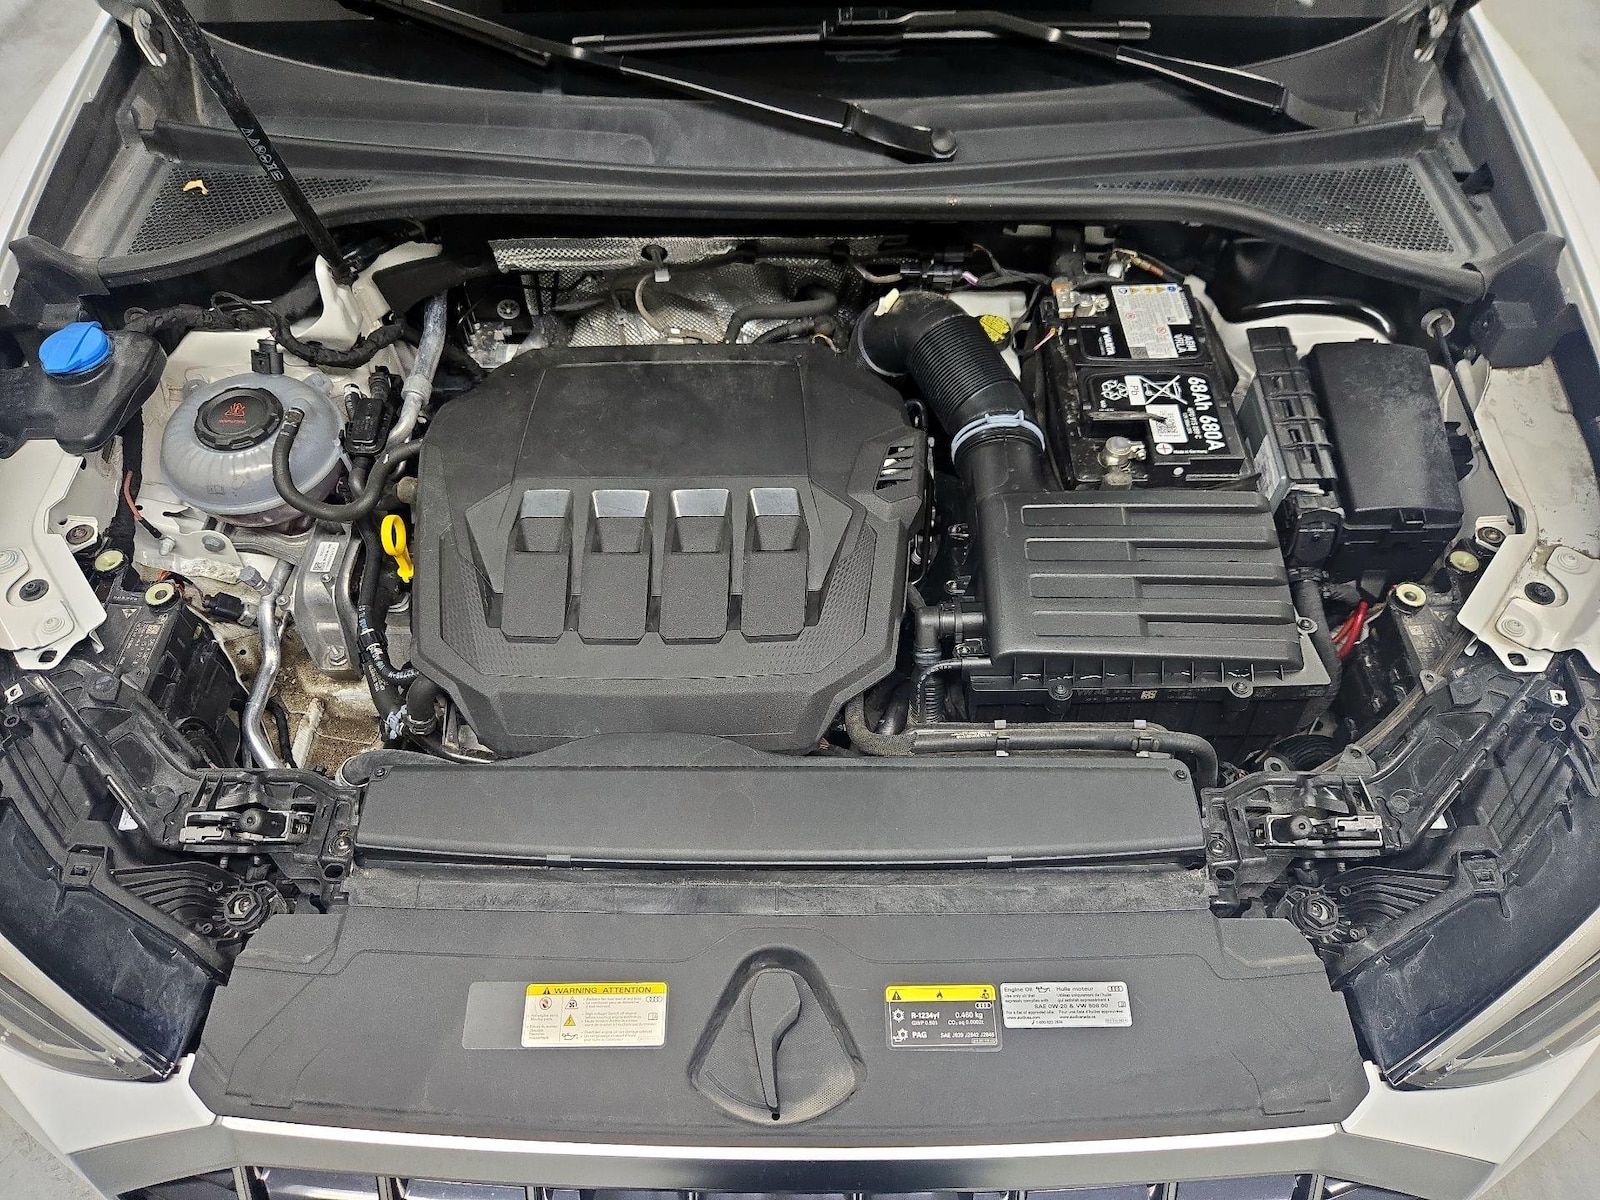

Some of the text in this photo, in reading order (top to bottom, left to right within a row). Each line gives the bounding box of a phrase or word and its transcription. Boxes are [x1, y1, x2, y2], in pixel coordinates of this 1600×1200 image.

[1103, 333, 1116, 356] VARTA
[1174, 333, 1186, 354] VRLA
[1130, 386, 1140, 396] Pb
[1188, 376, 1214, 410] 68Ah
[1199, 415, 1226, 450] 680A
[911, 1012, 940, 1020] R-1234yf
[975, 1012, 983, 1020] kg
